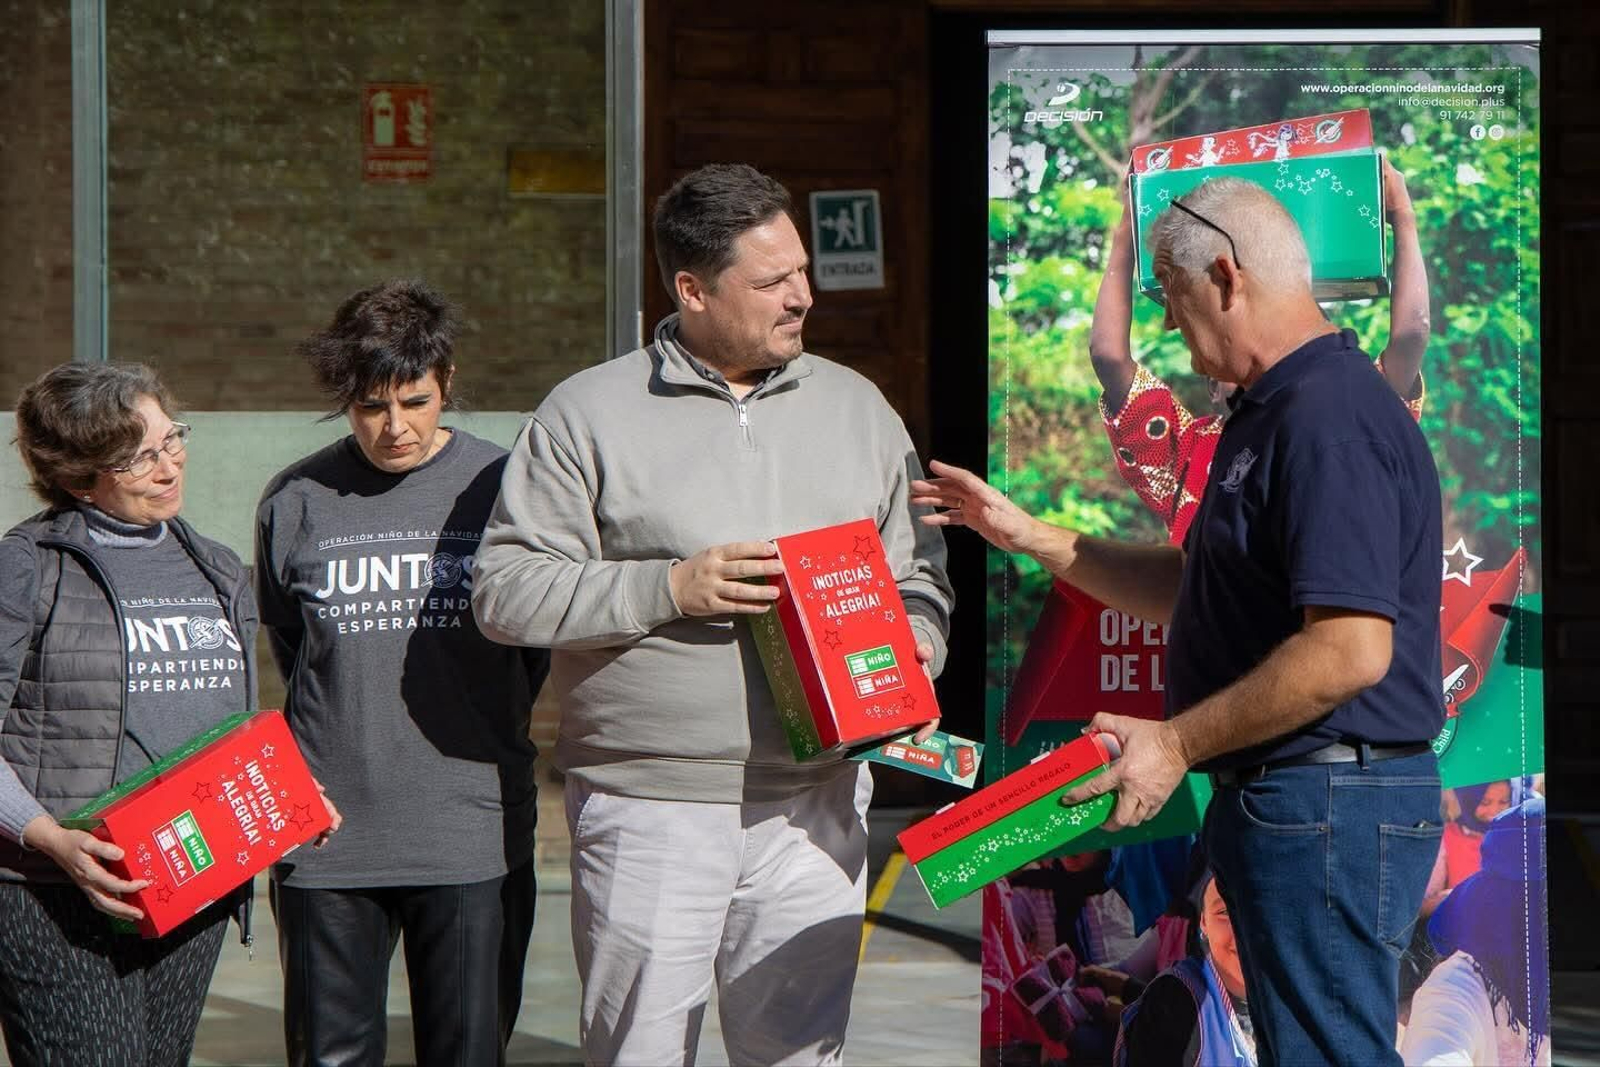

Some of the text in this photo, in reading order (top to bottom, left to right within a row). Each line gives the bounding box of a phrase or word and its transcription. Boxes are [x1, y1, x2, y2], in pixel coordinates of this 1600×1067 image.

[1301, 83, 1505, 95] www.operacionninodelanavidad.org
[1398, 97, 1505, 108] info@decision.plus
[1440, 110, 1505, 120] 91 742 79 11
[318, 533, 373, 548] OPERACIÓN
[378, 530, 403, 539] NIÑO
[442, 531, 483, 539] NAVIDA
[318, 598, 469, 619] COMPARTIEND
[826, 592, 881, 618] ALEGRÍA!
[337, 615, 462, 634] ESPERANZA
[128, 658, 244, 675] PARTIEND
[1100, 654, 1165, 691] DE L
[128, 676, 232, 693] SPERANZA
[943, 815, 970, 833] PODER
[972, 807, 984, 819] DE
[984, 801, 997, 811] UN
[998, 781, 1037, 807] SENCILLO
[1038, 762, 1071, 783] REGALO
